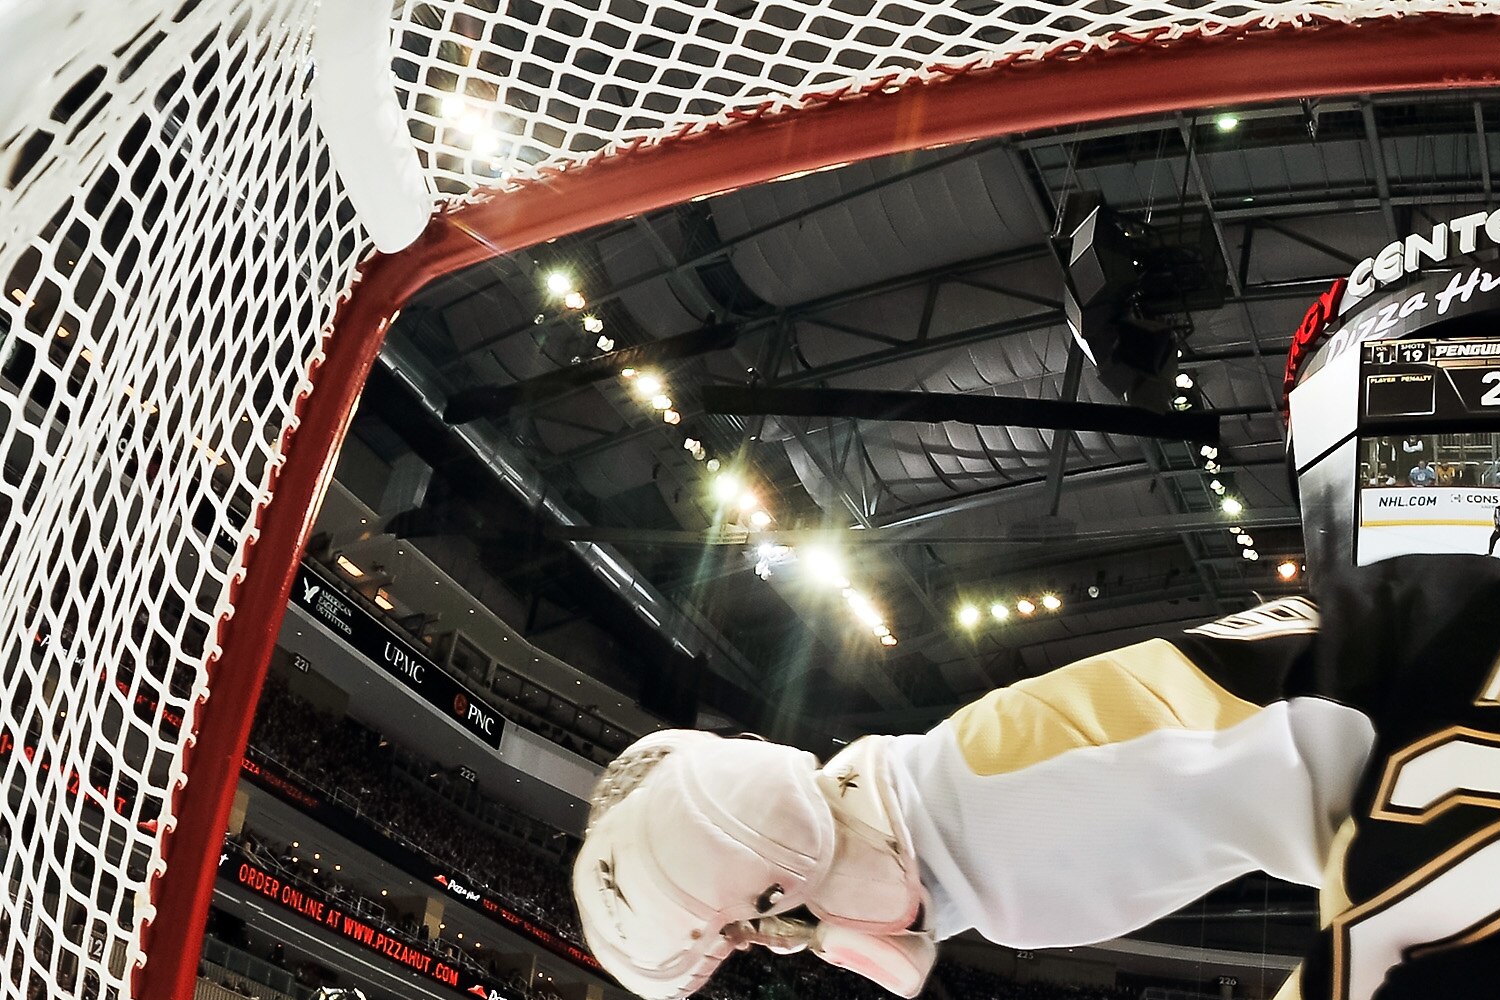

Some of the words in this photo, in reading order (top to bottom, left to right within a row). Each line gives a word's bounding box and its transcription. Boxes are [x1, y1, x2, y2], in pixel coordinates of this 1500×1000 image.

[1376, 352, 1386, 363] 1
[1403, 351, 1423, 363] 19
[1378, 496, 1437, 508] NHL.COM
[294, 656, 309, 673] 221
[384, 641, 425, 684] UPMC
[467, 704, 495, 736] PNC
[459, 766, 477, 783] 222
[238, 863, 279, 898] ORDER
[282, 886, 324, 922] ONLINE
[325, 908, 342, 927] AT
[1219, 976, 1237, 986] 226
